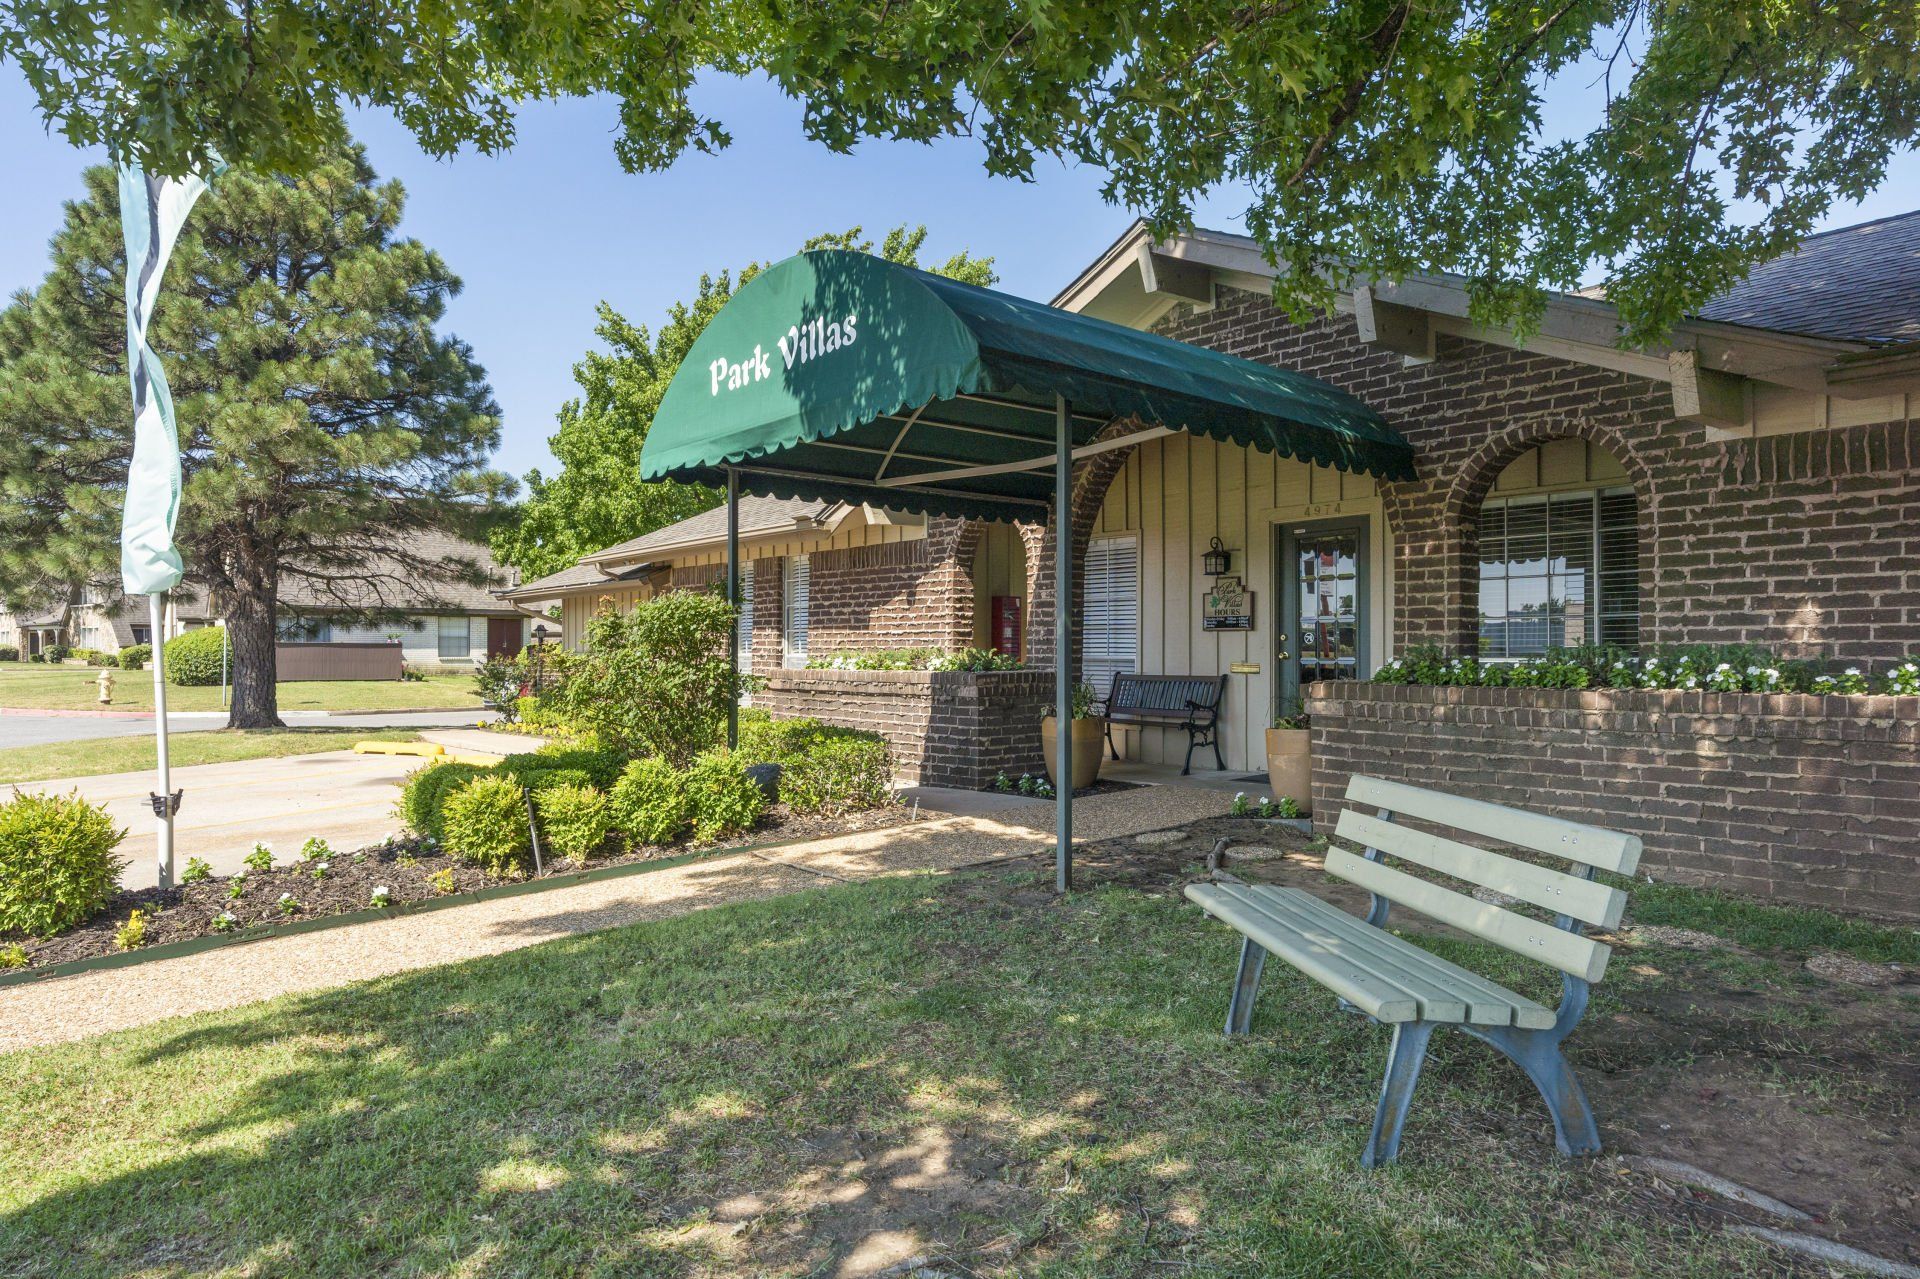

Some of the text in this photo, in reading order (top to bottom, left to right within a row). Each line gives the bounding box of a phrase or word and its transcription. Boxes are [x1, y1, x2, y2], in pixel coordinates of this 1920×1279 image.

[709, 315, 857, 396] Park Villas
[1304, 503, 1341, 517] 4974
[1217, 582, 1238, 595] Park
[1220, 593, 1243, 608] Villas
